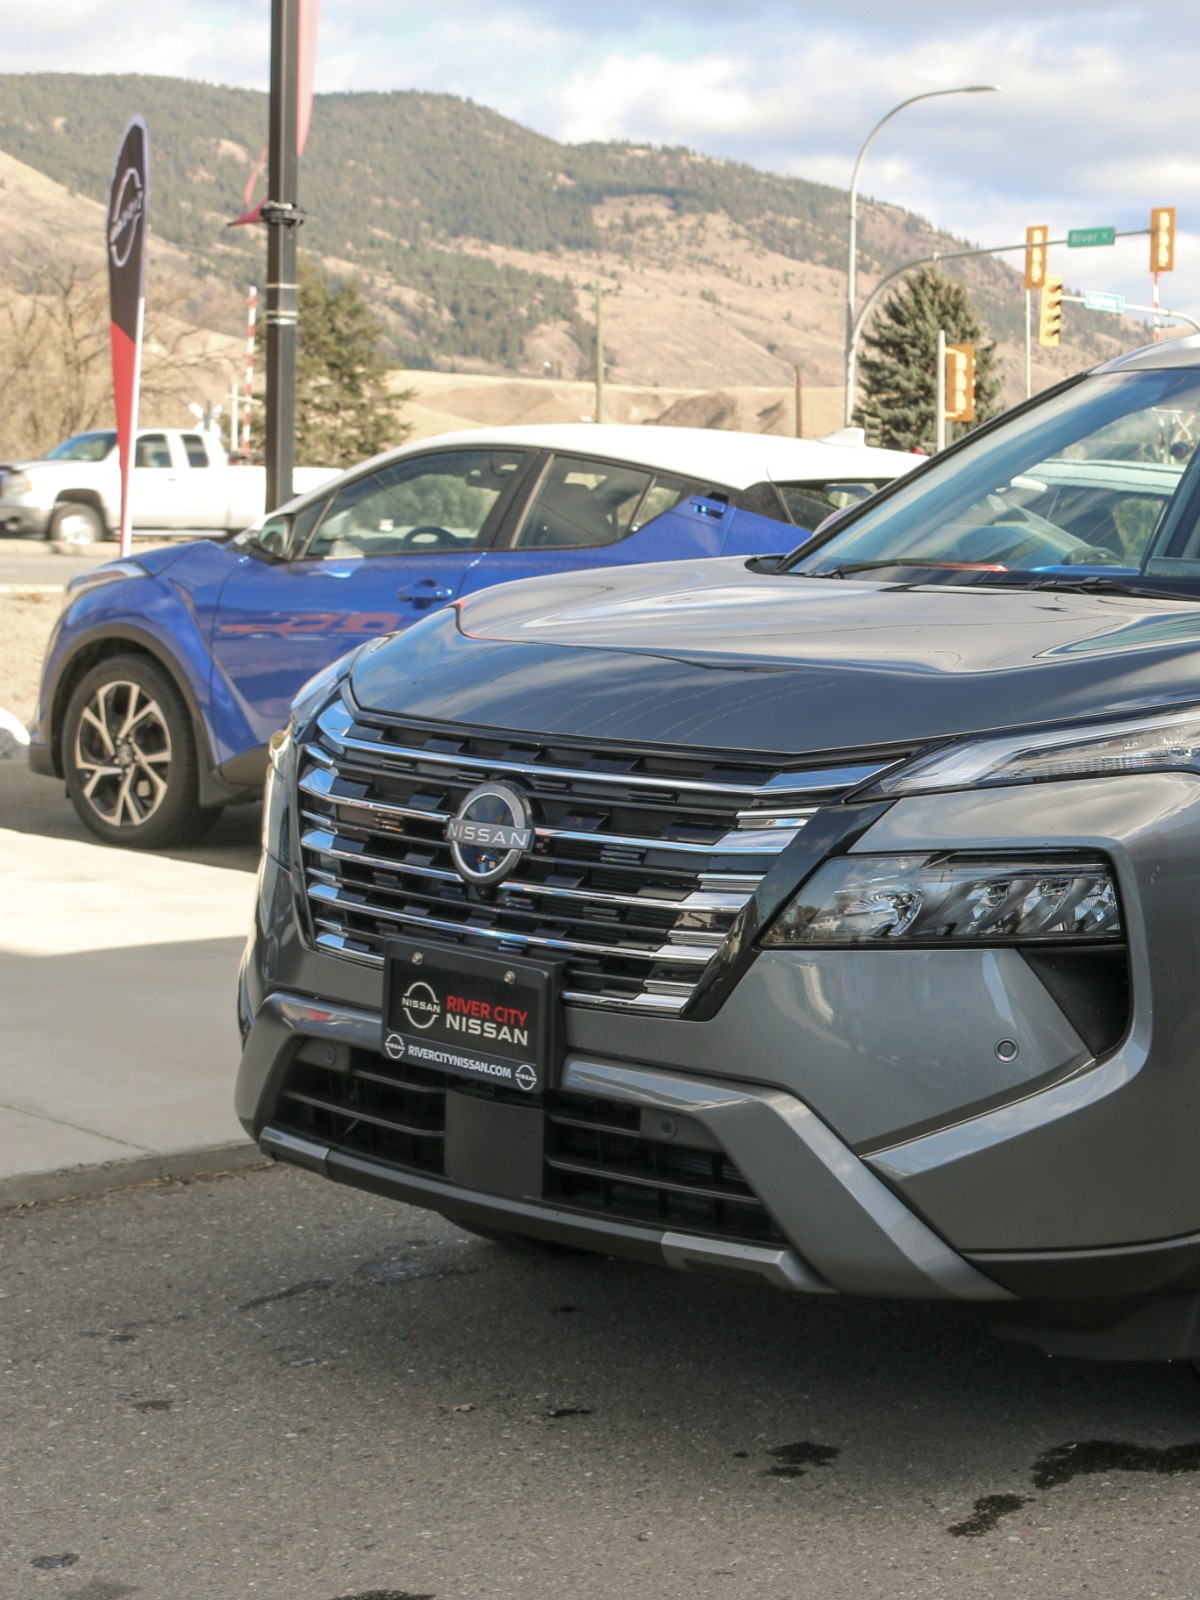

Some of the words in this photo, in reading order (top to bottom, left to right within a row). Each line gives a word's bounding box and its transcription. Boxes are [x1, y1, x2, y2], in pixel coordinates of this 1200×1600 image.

[447, 823, 527, 846] NISSAN
[401, 997, 441, 1013] NISSAN
[446, 995, 490, 1019] RIVER
[494, 1006, 528, 1027] CITY
[446, 1013, 528, 1046] NISSAN
[408, 1045, 512, 1078] RIVERCITYNISSAN.COM
